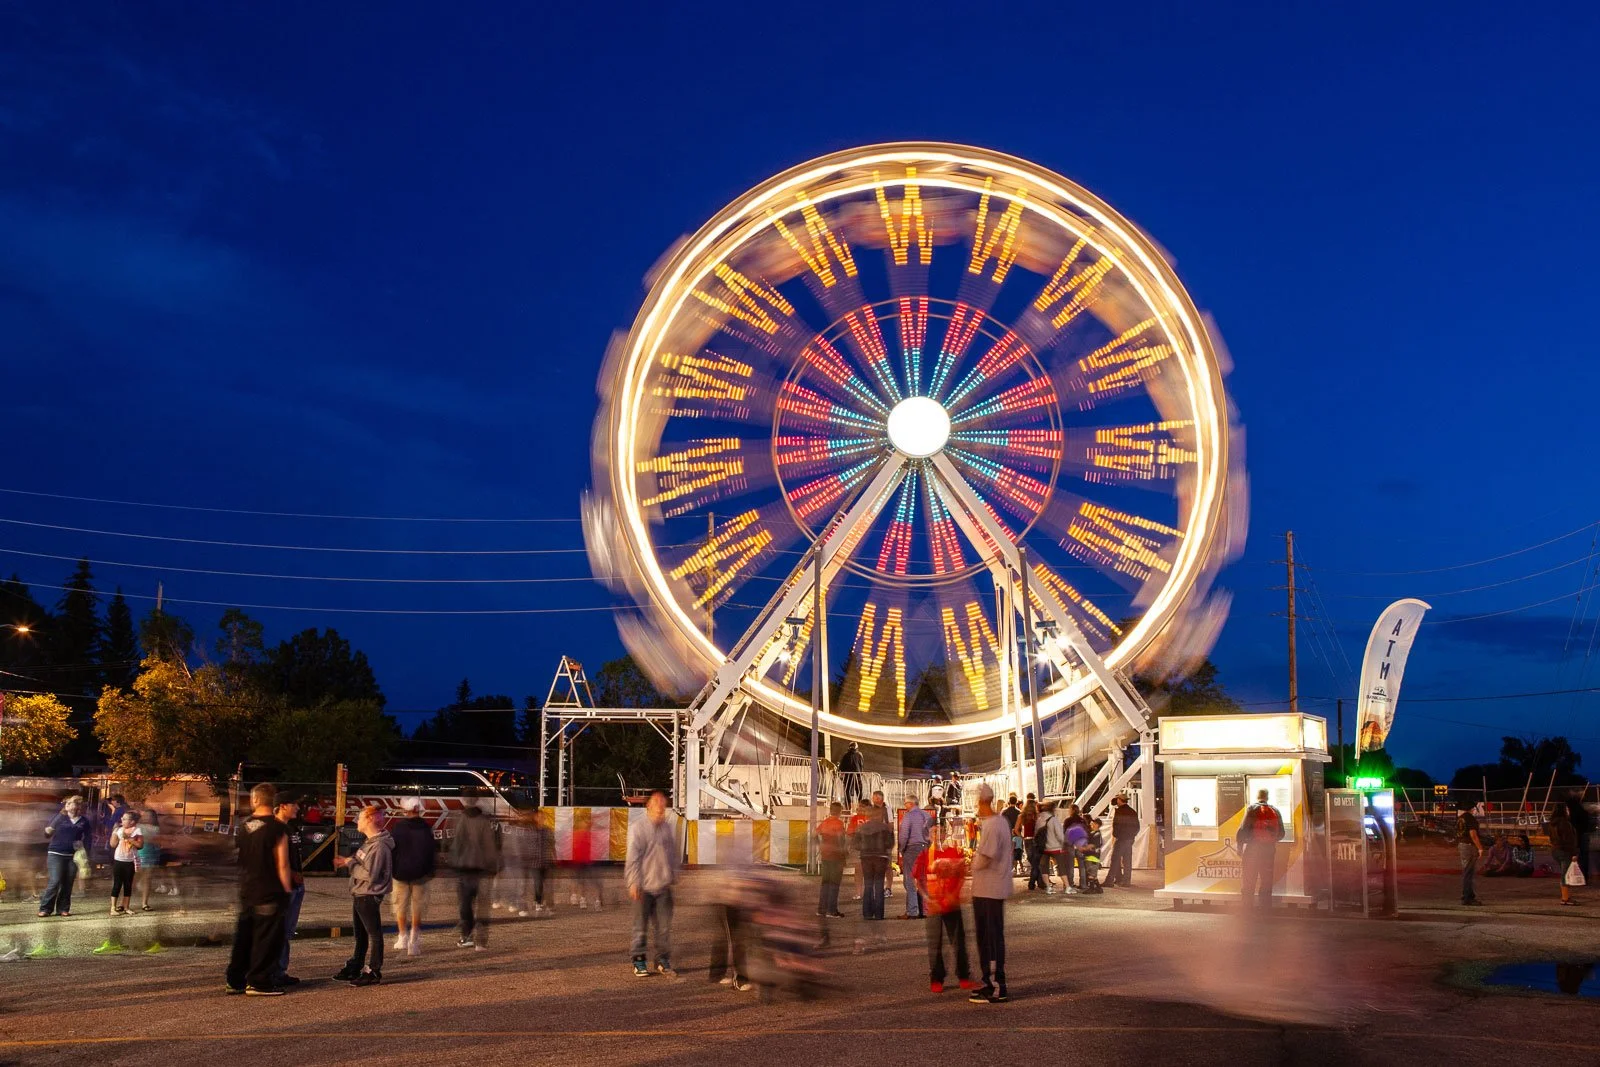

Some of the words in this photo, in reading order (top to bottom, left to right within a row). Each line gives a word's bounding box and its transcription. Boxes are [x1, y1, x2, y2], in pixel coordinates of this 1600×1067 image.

[1379, 618, 1403, 680] ATM
[1334, 797, 1341, 806] GO
[1337, 843, 1356, 861] ATM
